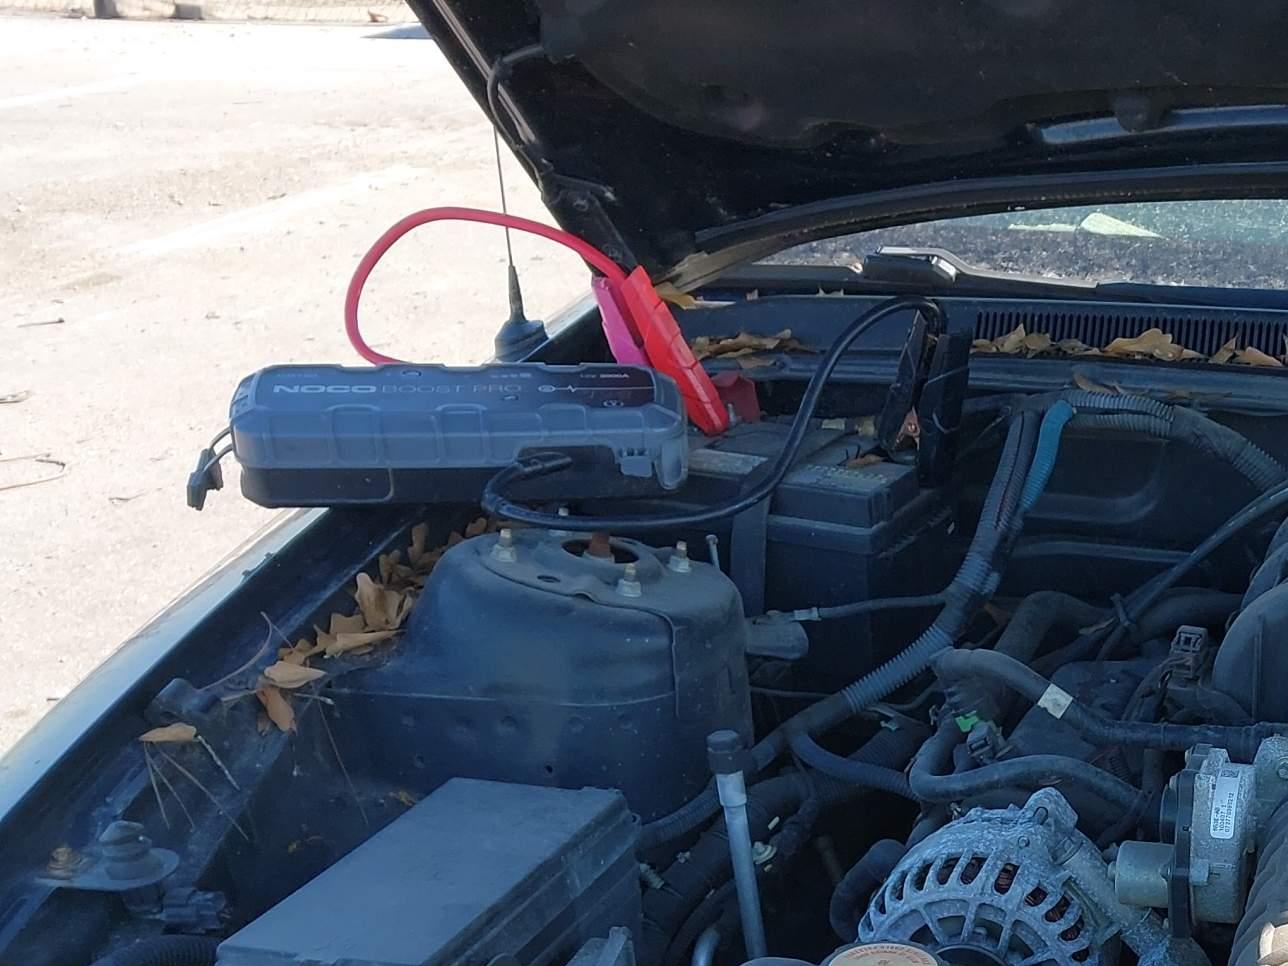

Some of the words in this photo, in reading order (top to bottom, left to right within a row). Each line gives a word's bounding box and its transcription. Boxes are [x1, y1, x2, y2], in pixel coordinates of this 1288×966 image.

[273, 384, 377, 393] NOCO
[382, 384, 464, 393] BOOST
[473, 384, 521, 393] PRO
